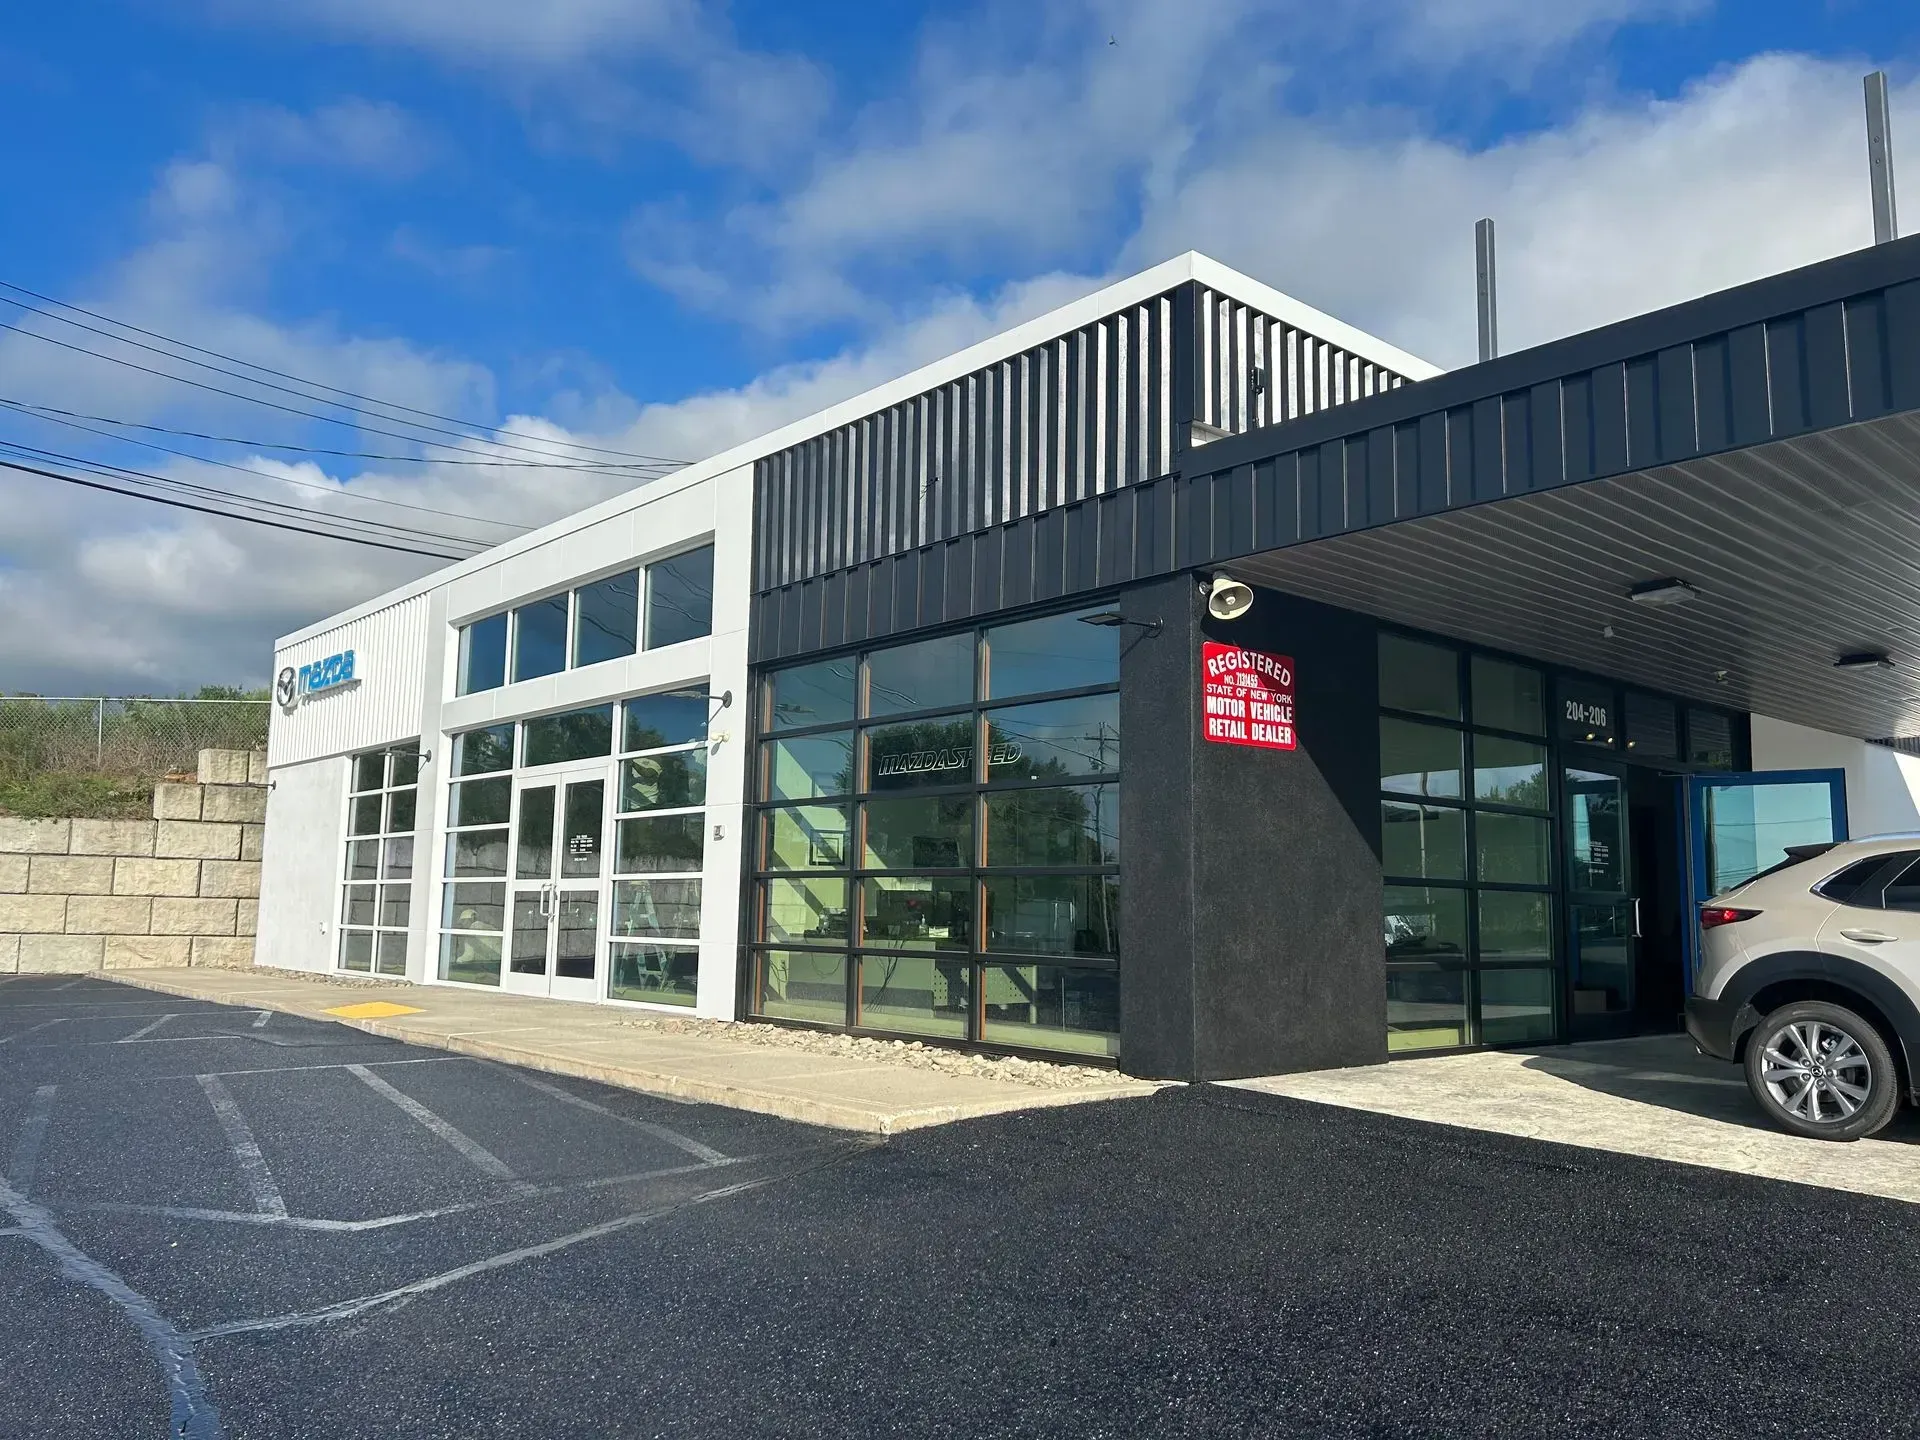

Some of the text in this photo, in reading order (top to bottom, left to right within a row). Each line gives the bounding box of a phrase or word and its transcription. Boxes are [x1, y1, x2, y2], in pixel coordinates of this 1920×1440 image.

[1207, 651, 1291, 687] REGISTERED
[1206, 683, 1292, 704] STATE OF NEW YORK
[1206, 695, 1293, 724] MOTOR VEHICLE
[1566, 700, 1606, 727] 204-206
[1208, 717, 1292, 745] RETAIL DEALER
